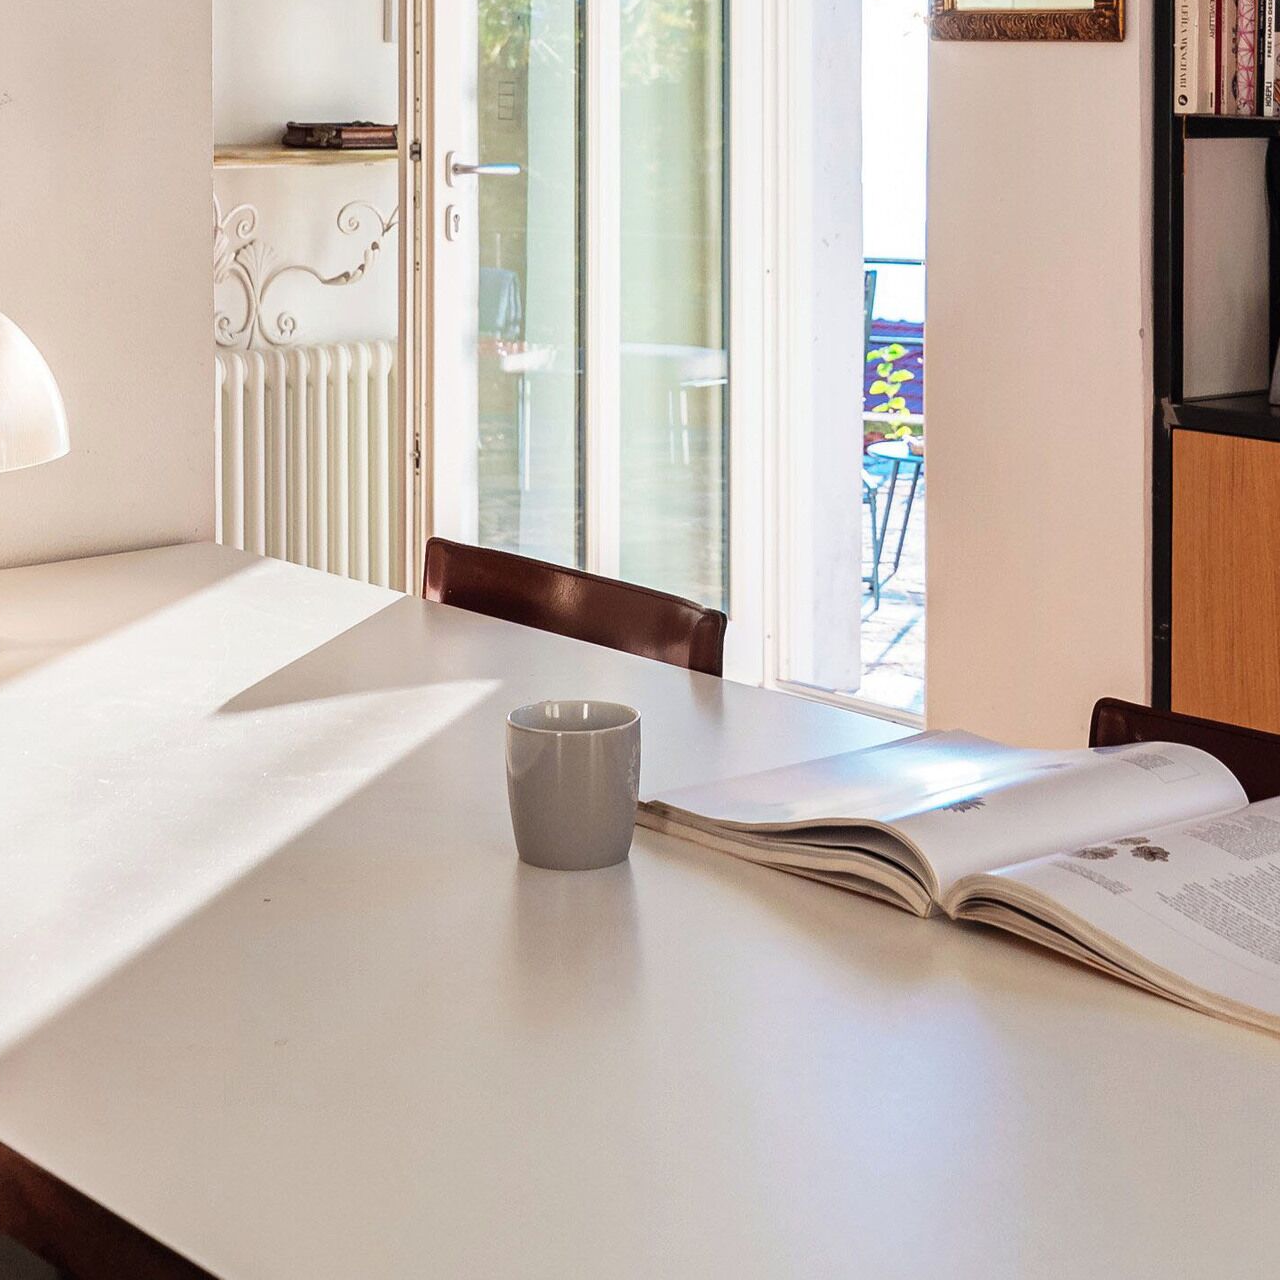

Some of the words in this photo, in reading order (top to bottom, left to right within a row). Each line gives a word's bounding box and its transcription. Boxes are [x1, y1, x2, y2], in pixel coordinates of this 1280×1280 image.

[1180, 4, 1191, 34] LEÏLA
[1180, 36, 1189, 89] MENCHARI
[1265, 81, 1273, 108] HOEPLI
